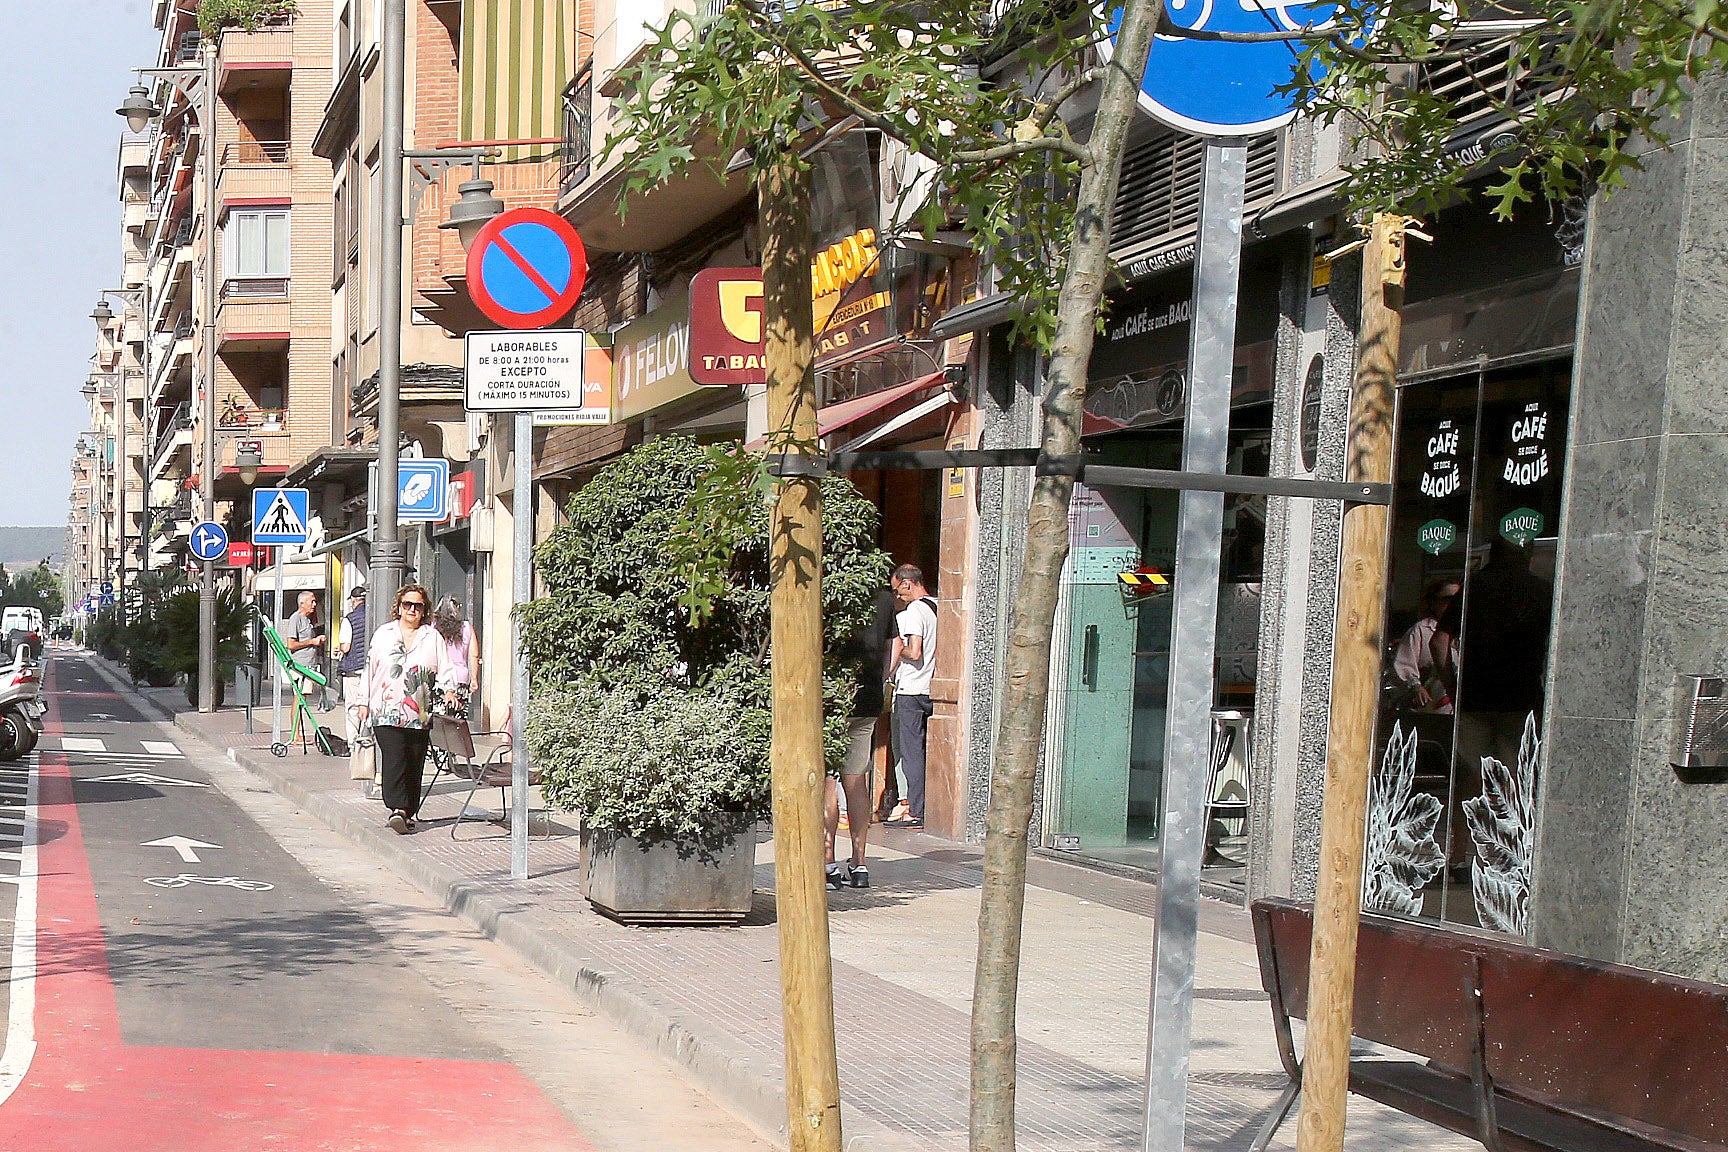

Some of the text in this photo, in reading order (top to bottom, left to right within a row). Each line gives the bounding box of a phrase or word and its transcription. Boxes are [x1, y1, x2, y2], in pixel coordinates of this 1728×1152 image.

[1130, 245, 1195, 277] AQUÍ CAFÉ SE DICE
[1125, 306, 1148, 337] CAFÉ
[1148, 318, 1154, 331] SE
[1155, 314, 1168, 329] DICE
[491, 342, 558, 352] LABORABLES
[493, 356, 512, 364] 8:00
[514, 356, 520, 364] A
[547, 355, 569, 363] horas
[501, 367, 547, 376] EXCEPTO
[487, 378, 560, 389] CORTA DURACIÓN
[519, 391, 527, 399] 15
[529, 390, 570, 400] MINUTOS)
[1511, 411, 1547, 443] CAFÉ
[1427, 428, 1459, 457] CAFÉ
[1517, 445, 1538, 456] SE DICE
[1433, 460, 1451, 470] SE DICE
[1503, 449, 1549, 486] BAQUÉ
[1421, 463, 1460, 498] BAQUÉ
[1505, 515, 1539, 532] BAQUÉ
[1422, 525, 1452, 542] BAQUÉ
